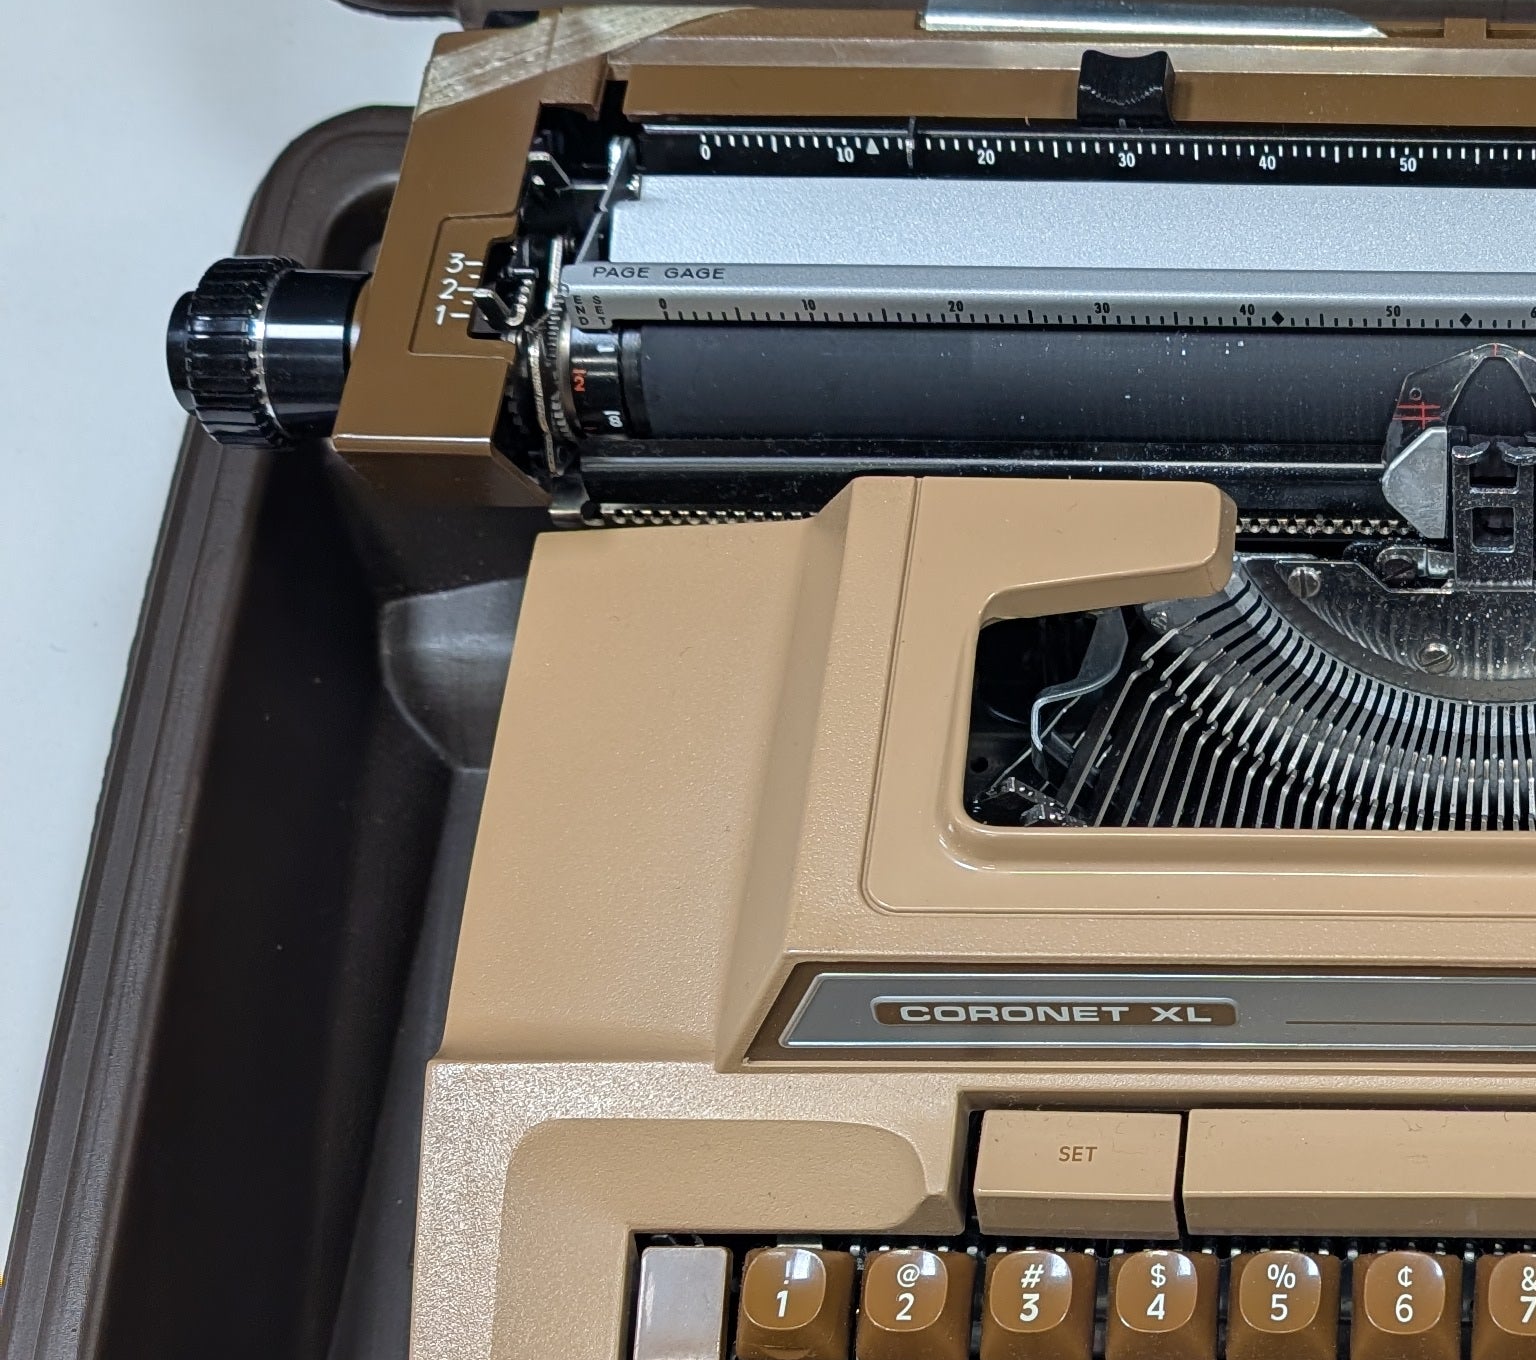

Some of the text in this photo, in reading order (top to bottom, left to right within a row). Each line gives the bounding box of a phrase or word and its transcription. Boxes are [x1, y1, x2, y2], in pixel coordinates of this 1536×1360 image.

[701, 145, 711, 160] 0
[837, 147, 854, 163] 10
[977, 149, 995, 165] 20
[1118, 153, 1136, 168] 30
[1259, 156, 1276, 171] 40
[1400, 158, 1417, 173] 50
[446, 253, 465, 273] 3
[593, 267, 726, 279] PAGE GAGE
[438, 279, 458, 300] 2
[435, 305, 445, 326] 1
[658, 298, 667, 309] 0
[802, 300, 816, 312] 10
[948, 301, 964, 313] 20
[1094, 302, 1110, 315] 30
[1239, 304, 1255, 316] 40
[1386, 305, 1400, 317] 50
[899, 1005, 1212, 1023] CORONET XL
[1058, 1146, 1097, 1163] SET
[896, 1263, 920, 1288] @
[1020, 1263, 1044, 1288] #
[1150, 1263, 1167, 1288] $
[1267, 1263, 1296, 1289] %
[776, 1290, 788, 1317] 1
[895, 1293, 915, 1321] 2
[1019, 1293, 1039, 1322] 3
[1146, 1293, 1166, 1320] 4
[1270, 1294, 1288, 1321] 5
[1395, 1294, 1413, 1323] 6
